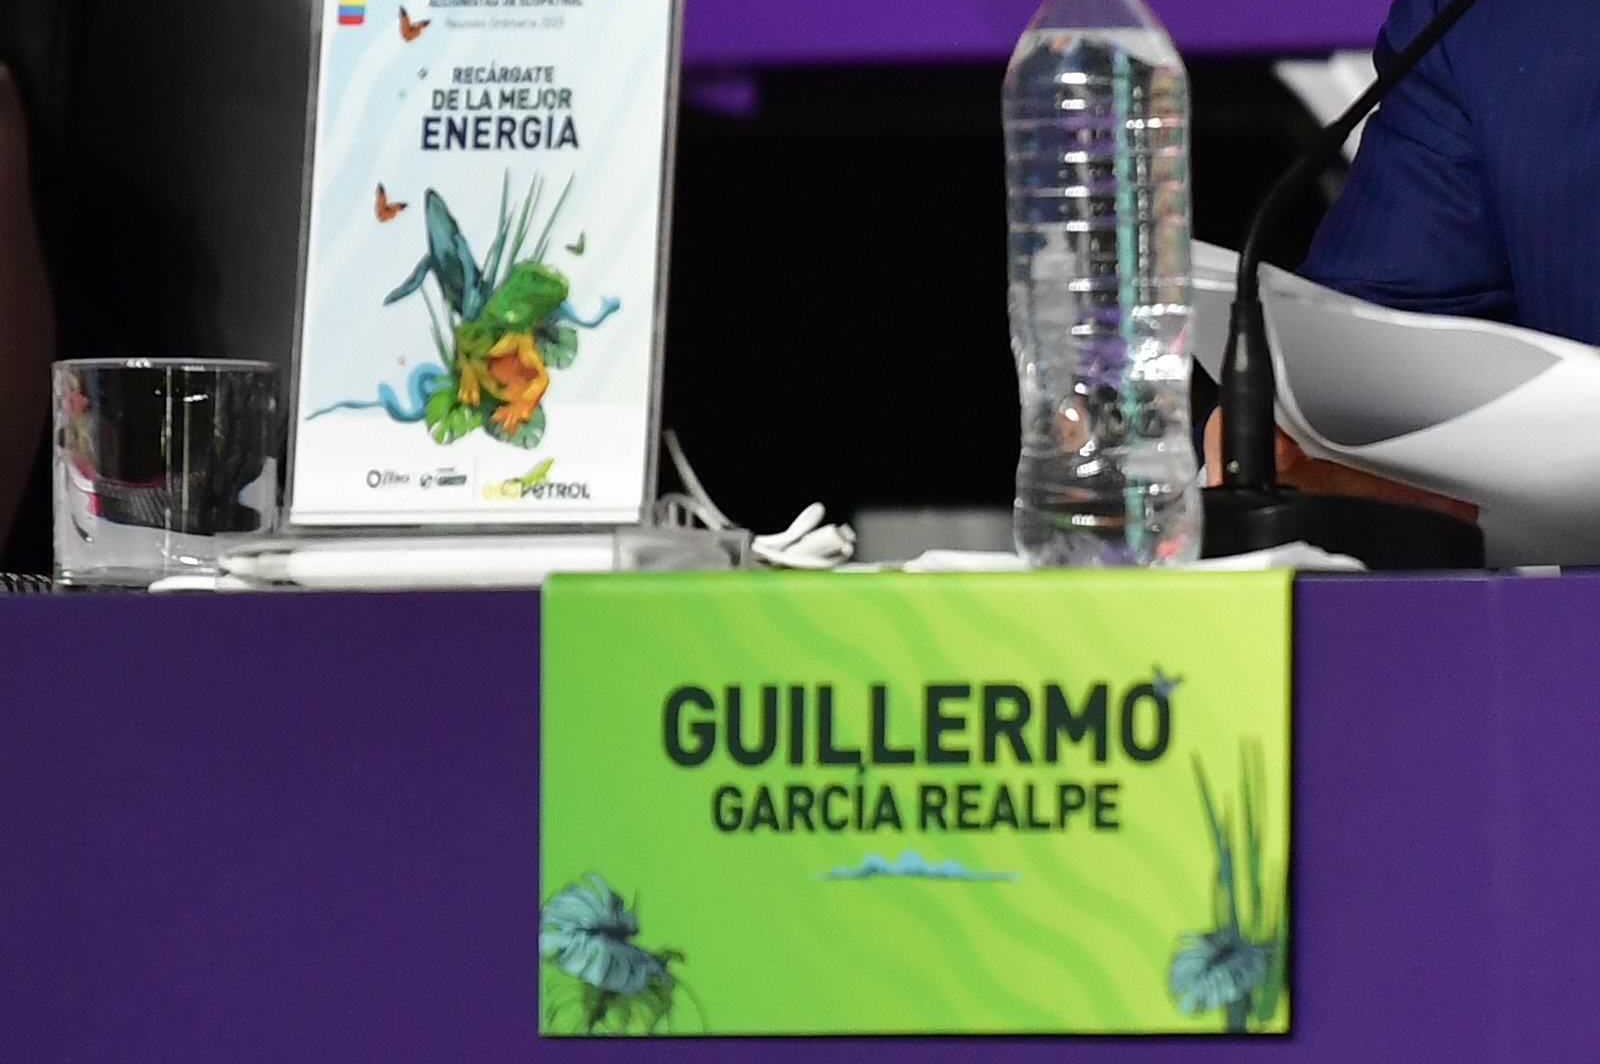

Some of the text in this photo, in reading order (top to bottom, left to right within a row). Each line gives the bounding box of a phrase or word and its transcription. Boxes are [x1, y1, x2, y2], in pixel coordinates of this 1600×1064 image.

[452, 61, 554, 84] RECÁRGATE
[432, 88, 572, 110] DE LA MEJOR
[421, 111, 579, 150] ENERGÍA
[663, 681, 1174, 767] GUILLERMO
[712, 768, 1122, 832] GARCÍA REALPE
